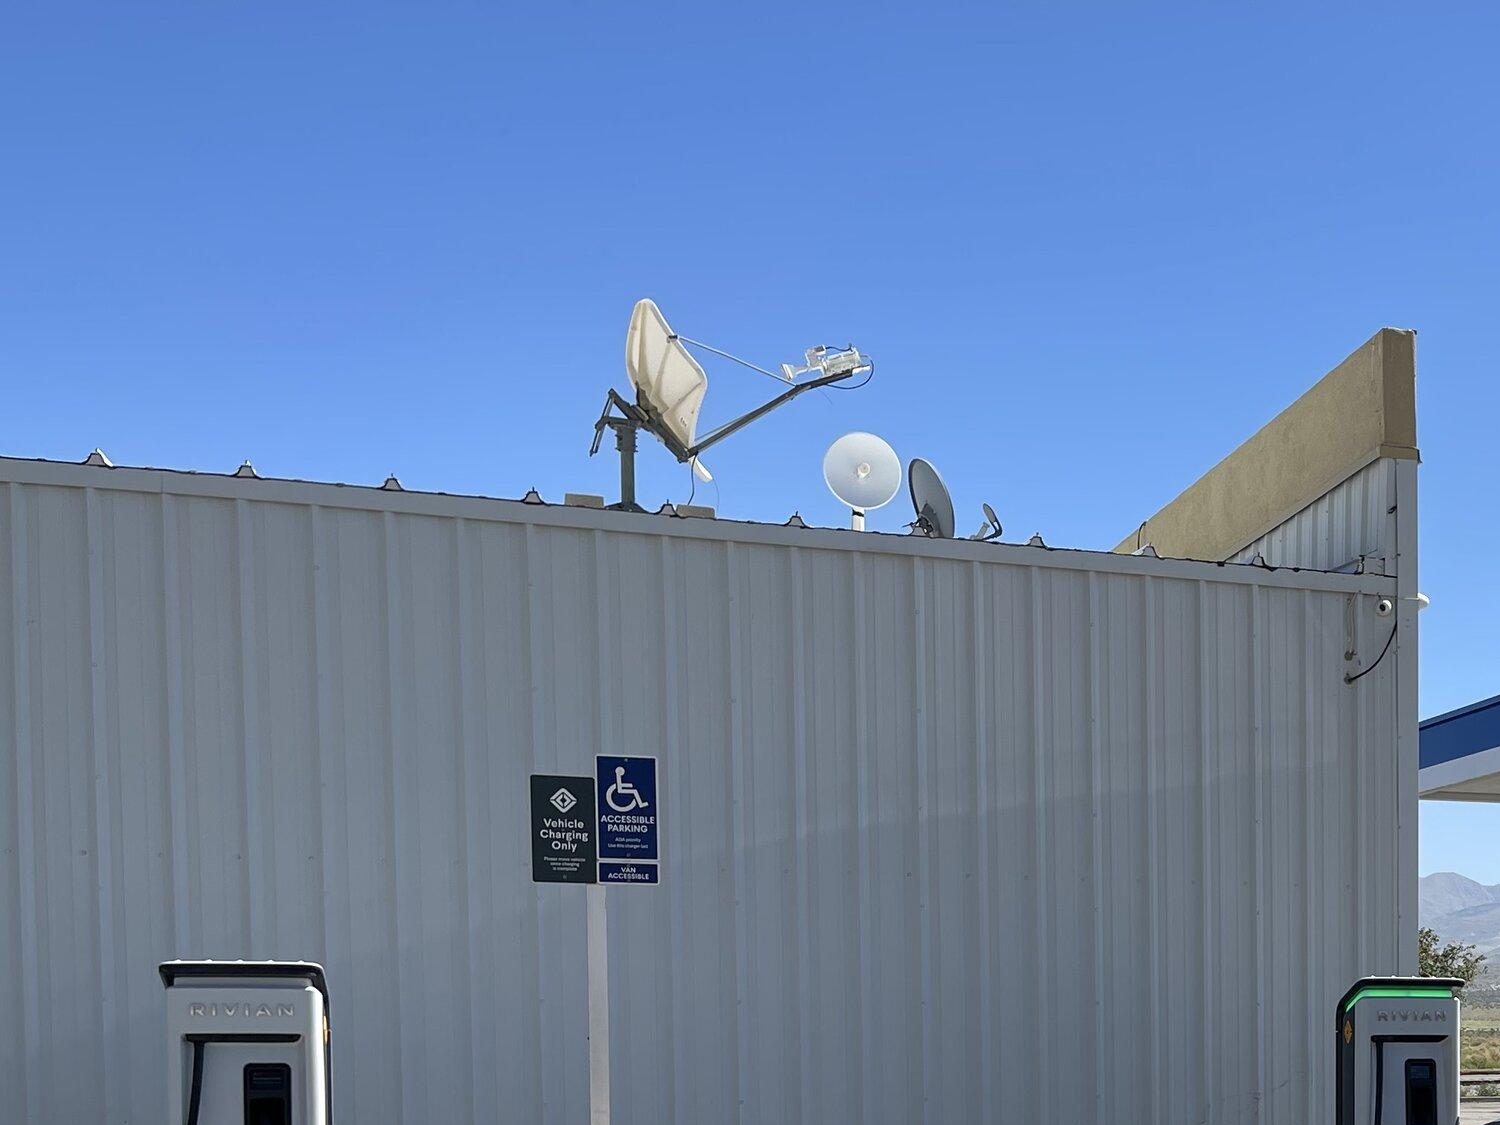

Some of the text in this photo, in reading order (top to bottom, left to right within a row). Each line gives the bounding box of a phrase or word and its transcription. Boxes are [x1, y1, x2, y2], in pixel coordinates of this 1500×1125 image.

[543, 818, 584, 829] Vehicle
[600, 815, 655, 825] ACCESSIBLE
[607, 824, 648, 833] PARKING
[540, 829, 589, 842] Charging
[551, 841, 577, 853] Only
[189, 1003, 295, 1017] RIVIAN
[1376, 1010, 1447, 1022] RIVIAN
